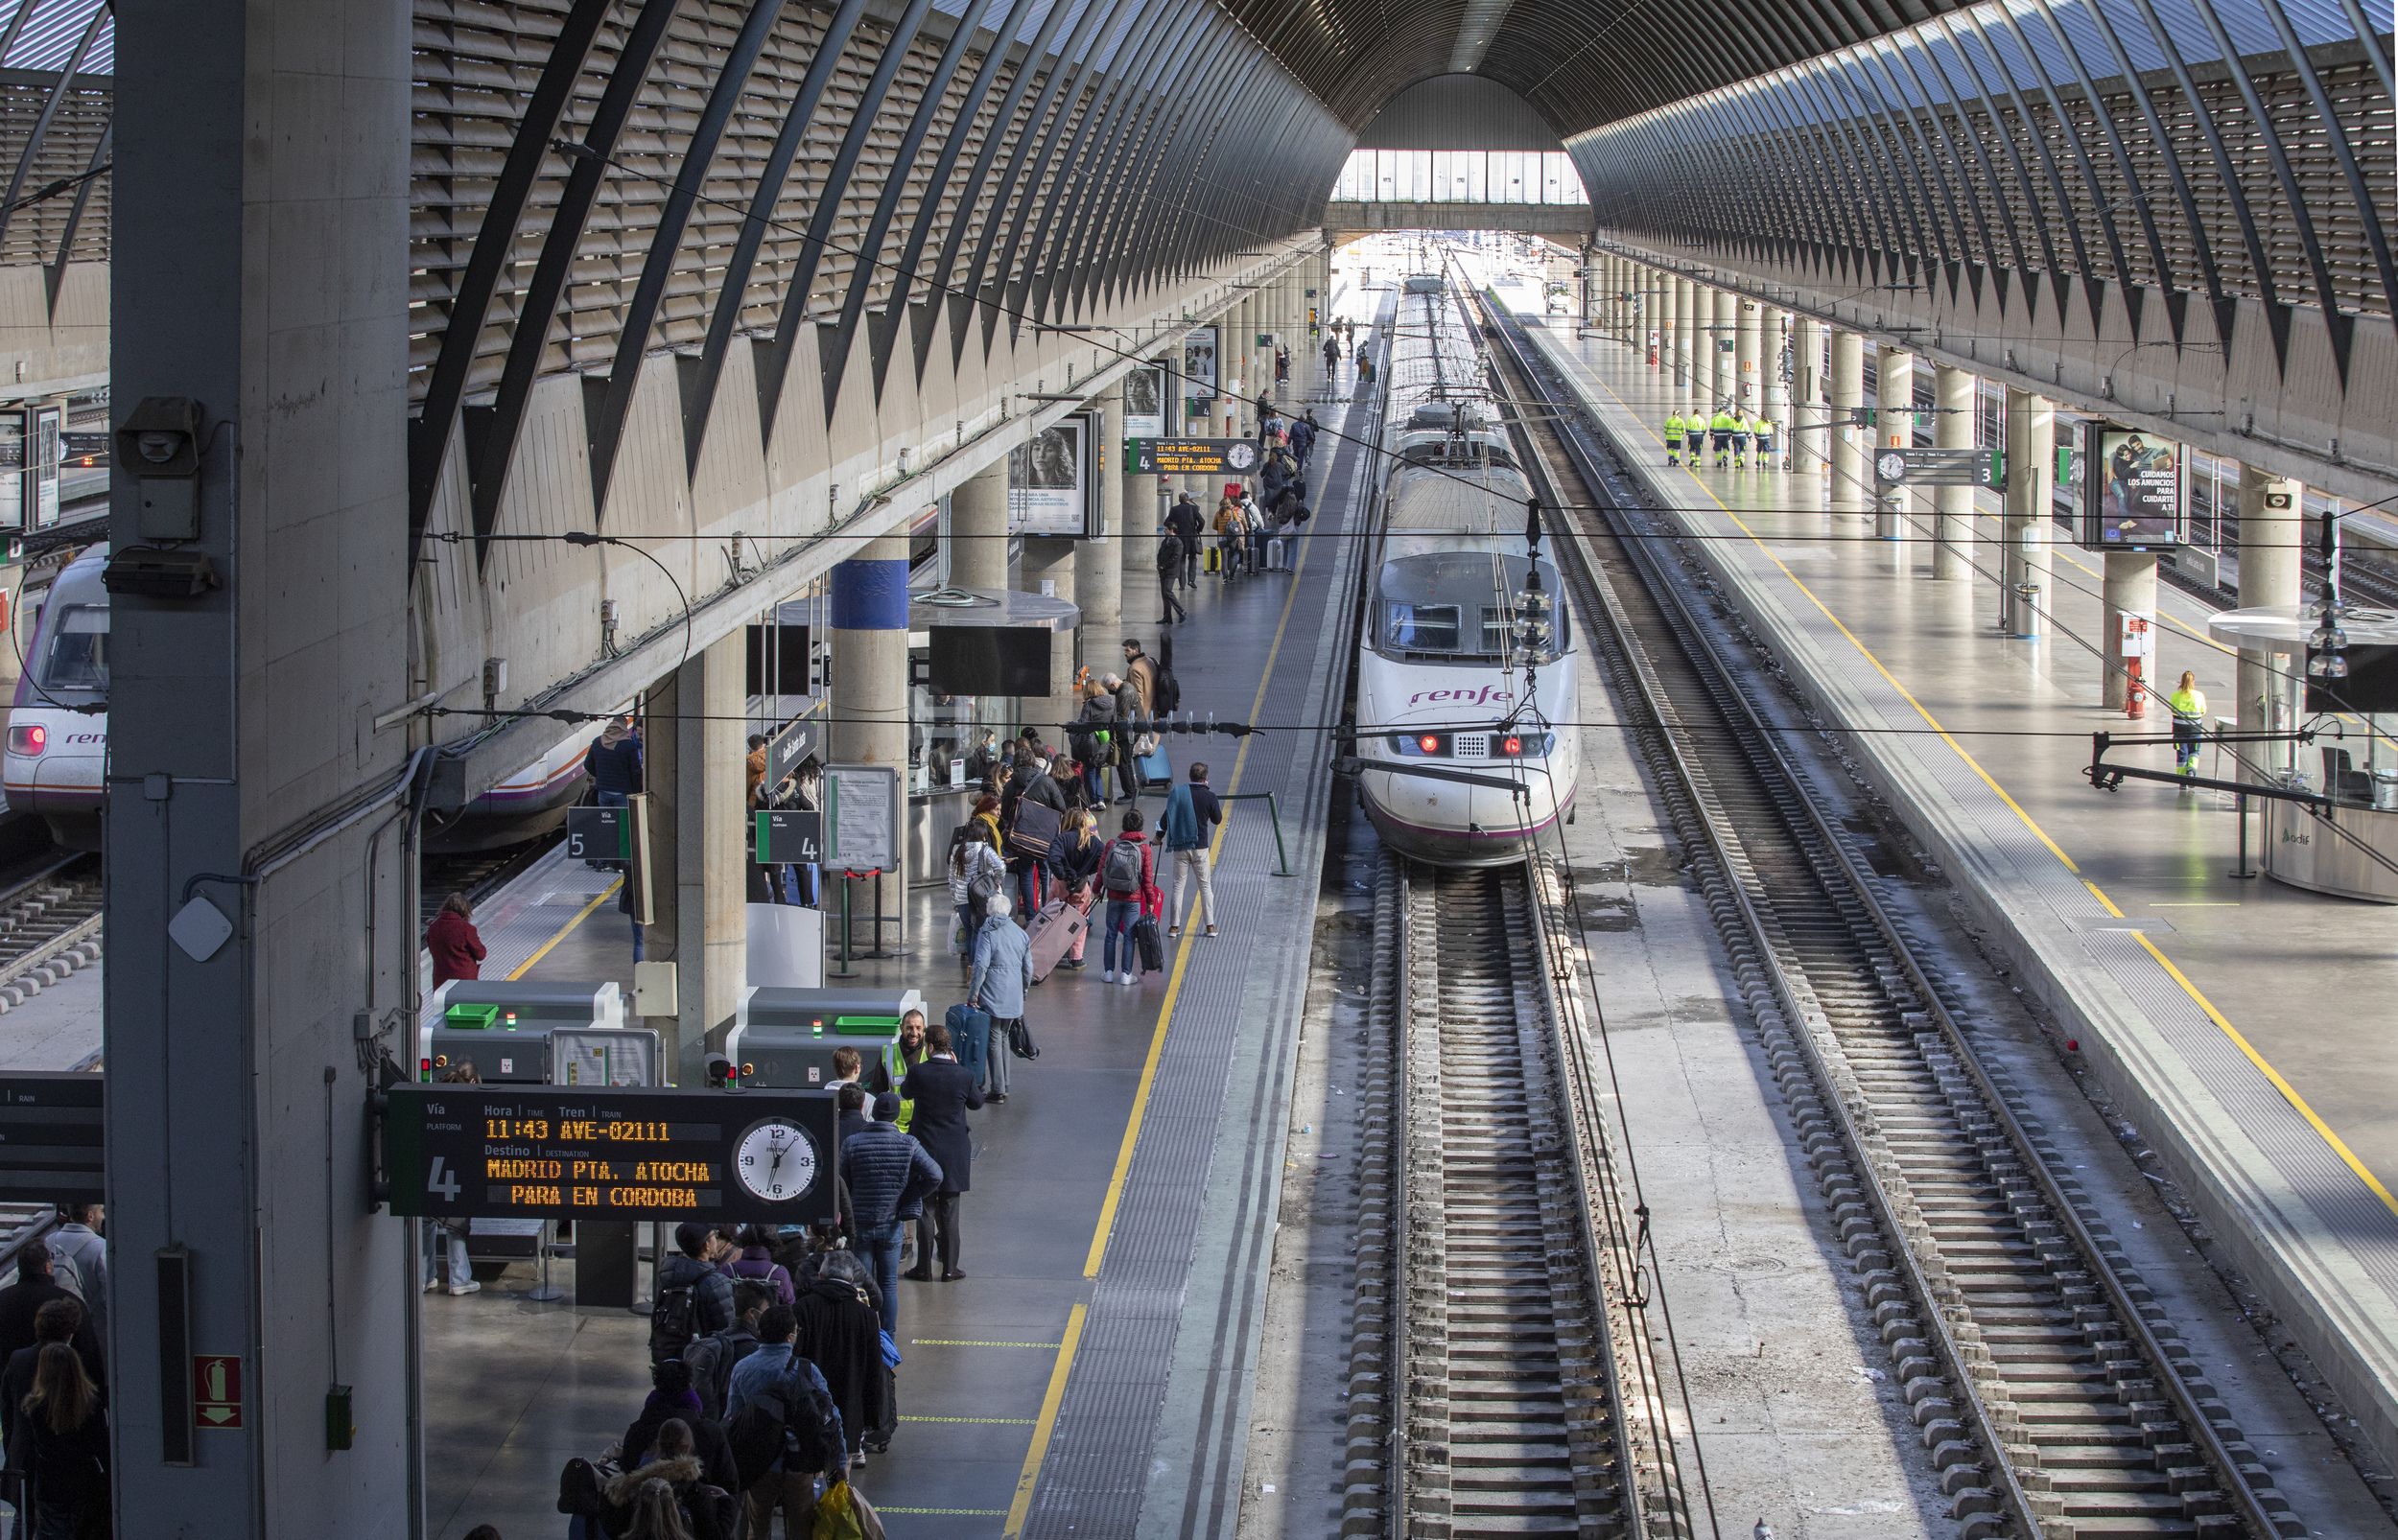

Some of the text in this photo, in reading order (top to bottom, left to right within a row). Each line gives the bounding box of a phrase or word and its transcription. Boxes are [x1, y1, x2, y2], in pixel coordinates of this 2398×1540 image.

[1204, 408, 1210, 416] 4
[1140, 455, 1150, 470] 4
[1982, 468, 1991, 482] 3
[2141, 478, 2175, 487] ANUNCIOS
[2142, 495, 2175, 503] CUIDARTE
[10, 537, 22, 558] D
[1411, 685, 1514, 706] renfe
[65, 734, 106, 744] ren
[572, 833, 584, 856] 5
[2291, 833, 2310, 846] adif
[801, 837, 818, 860] 4
[427, 1103, 445, 1115] Vía
[484, 1106, 545, 1118] Hora TIME
[558, 1107, 622, 1119] Tren TRAIN
[426, 1123, 461, 1132] PLATFORM
[486, 1119, 670, 1141] 11:43 AVE-02111
[769, 1129, 785, 1139] 12
[484, 1145, 589, 1160] Destino DESTINATION
[744, 1155, 755, 1166] 9
[800, 1156, 811, 1167] 3
[487, 1159, 710, 1182] MADRID PTA. ATOCHA
[428, 1156, 461, 1202] 4
[772, 1183, 783, 1195] 6
[511, 1185, 697, 1208] PARA EN CORDOBA
